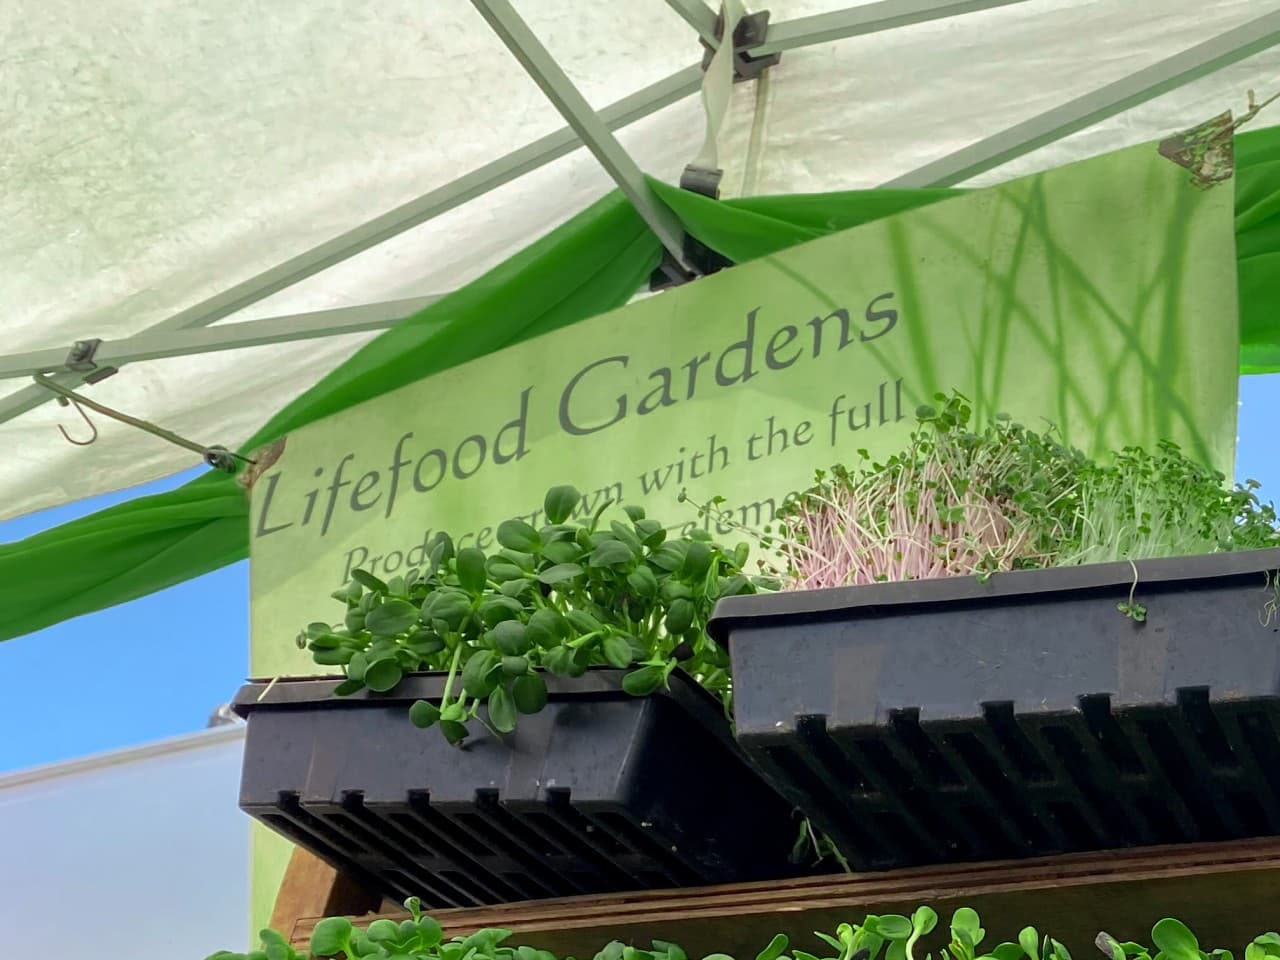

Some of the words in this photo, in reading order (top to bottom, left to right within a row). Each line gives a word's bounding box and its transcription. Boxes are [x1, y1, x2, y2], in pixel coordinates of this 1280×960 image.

[255, 384, 534, 538] Lifefood
[557, 291, 899, 437] Gardens
[340, 525, 494, 586] Prodce
[638, 433, 731, 496] with
[747, 415, 815, 462] the
[828, 376, 905, 448] full
